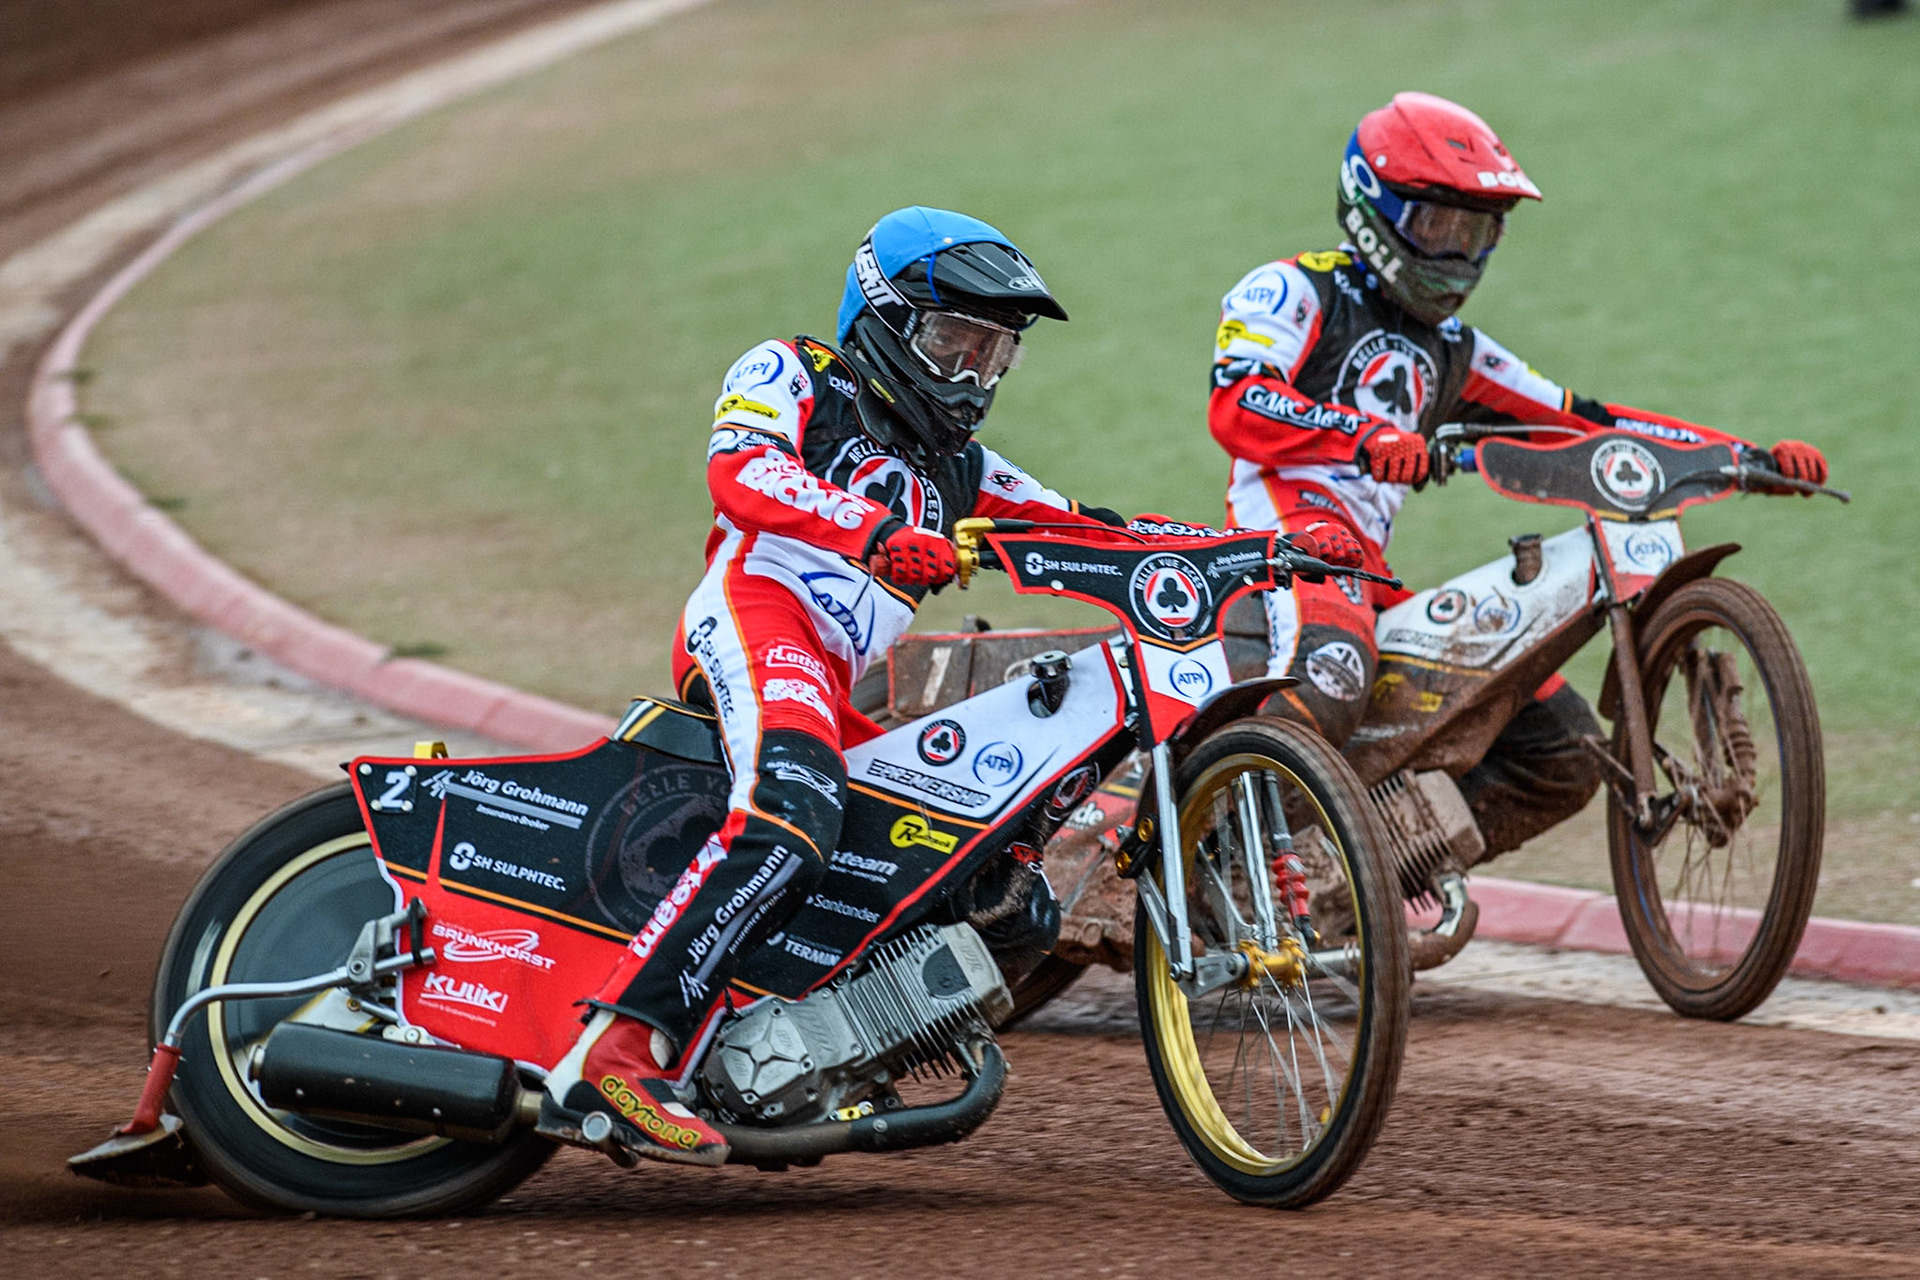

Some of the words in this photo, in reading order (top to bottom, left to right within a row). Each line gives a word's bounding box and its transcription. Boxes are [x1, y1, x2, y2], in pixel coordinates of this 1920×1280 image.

[1242, 287, 1277, 305] ATPI
[735, 457, 866, 530] RACING
[1134, 561, 1157, 591] BELLE
[1158, 557, 1181, 569] VUE
[1181, 564, 1205, 590] ACES
[1177, 673, 1206, 686] ATPI
[984, 753, 1014, 773] ATPI
[378, 770, 411, 808] 2
[461, 770, 500, 793] Jörg
[501, 780, 589, 816] Grohmann
[473, 854, 492, 871] SH
[687, 923, 720, 966] Jörg
[714, 844, 789, 925] Grohmann
[813, 893, 880, 923] Santander
[432, 923, 557, 970] BRUNKHORST
[601, 1075, 702, 1149] daytona
